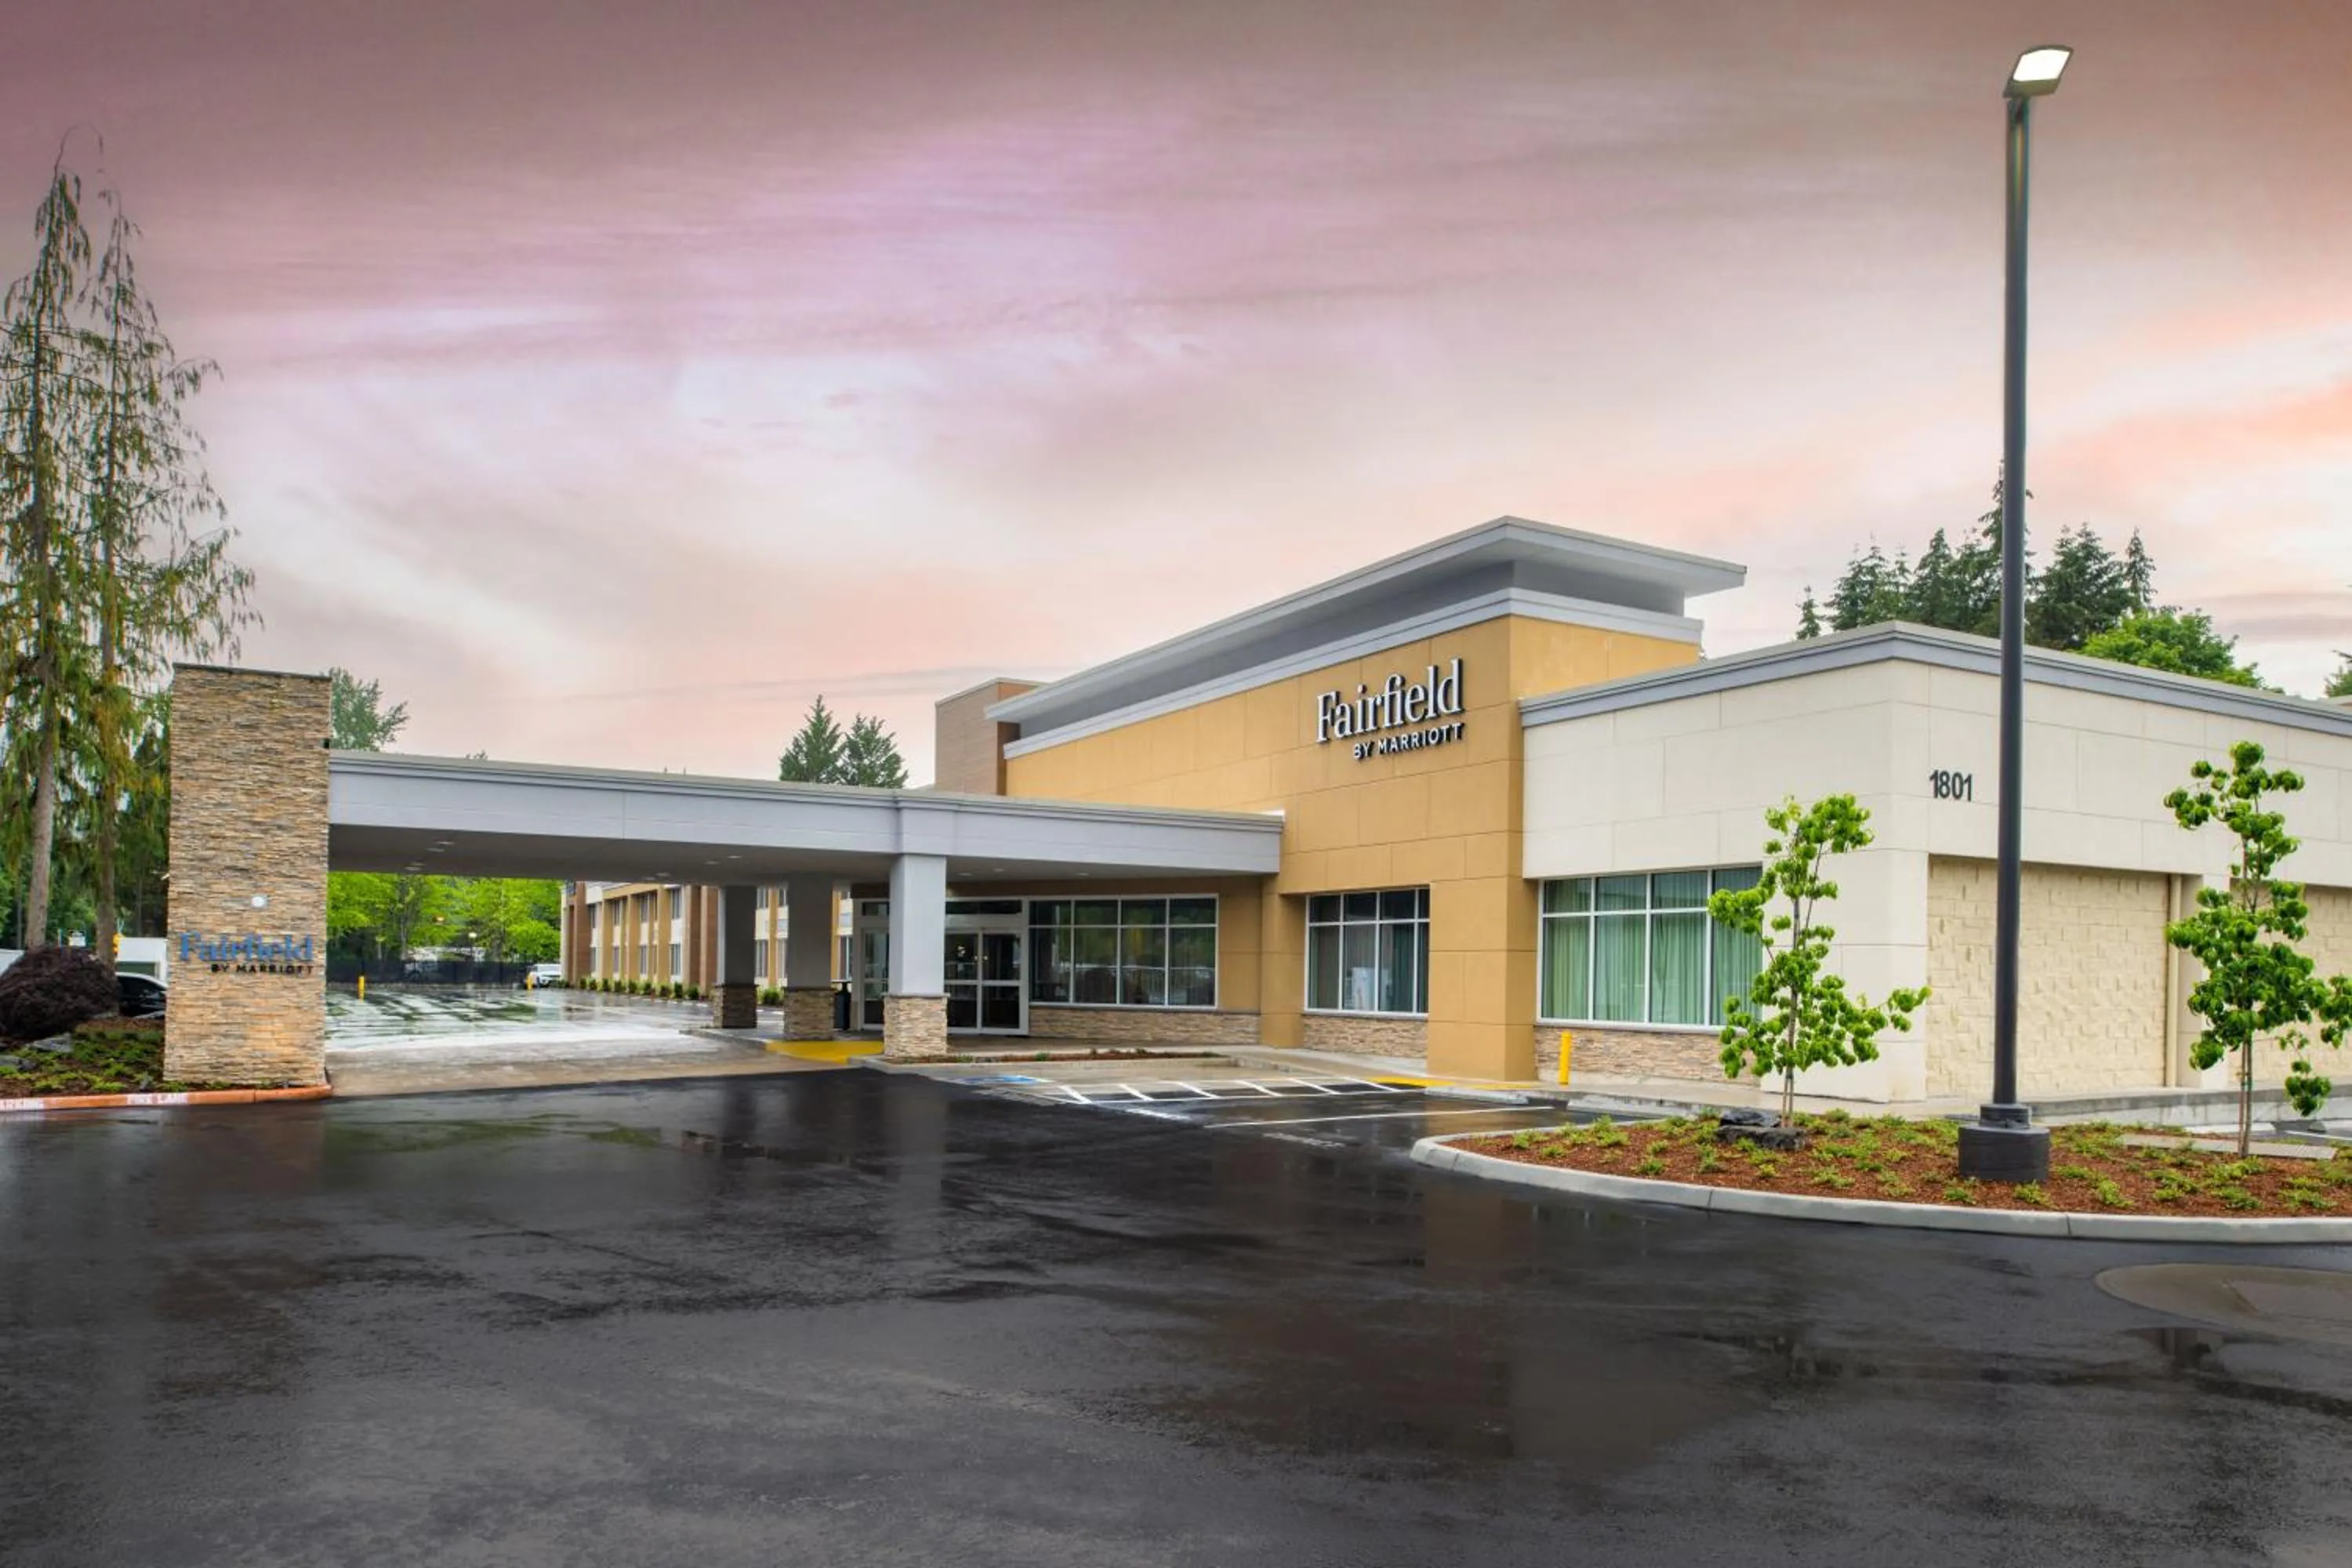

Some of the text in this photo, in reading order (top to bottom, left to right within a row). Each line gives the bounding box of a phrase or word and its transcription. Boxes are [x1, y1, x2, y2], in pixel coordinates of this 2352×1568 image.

[1316, 658, 1464, 743] Fairfield
[1354, 722, 1464, 759] BY MARRIOTT
[1929, 770, 1972, 802] 1801
[180, 931, 314, 961] Fairfield
[211, 964, 314, 974] BY MARRIOTT
